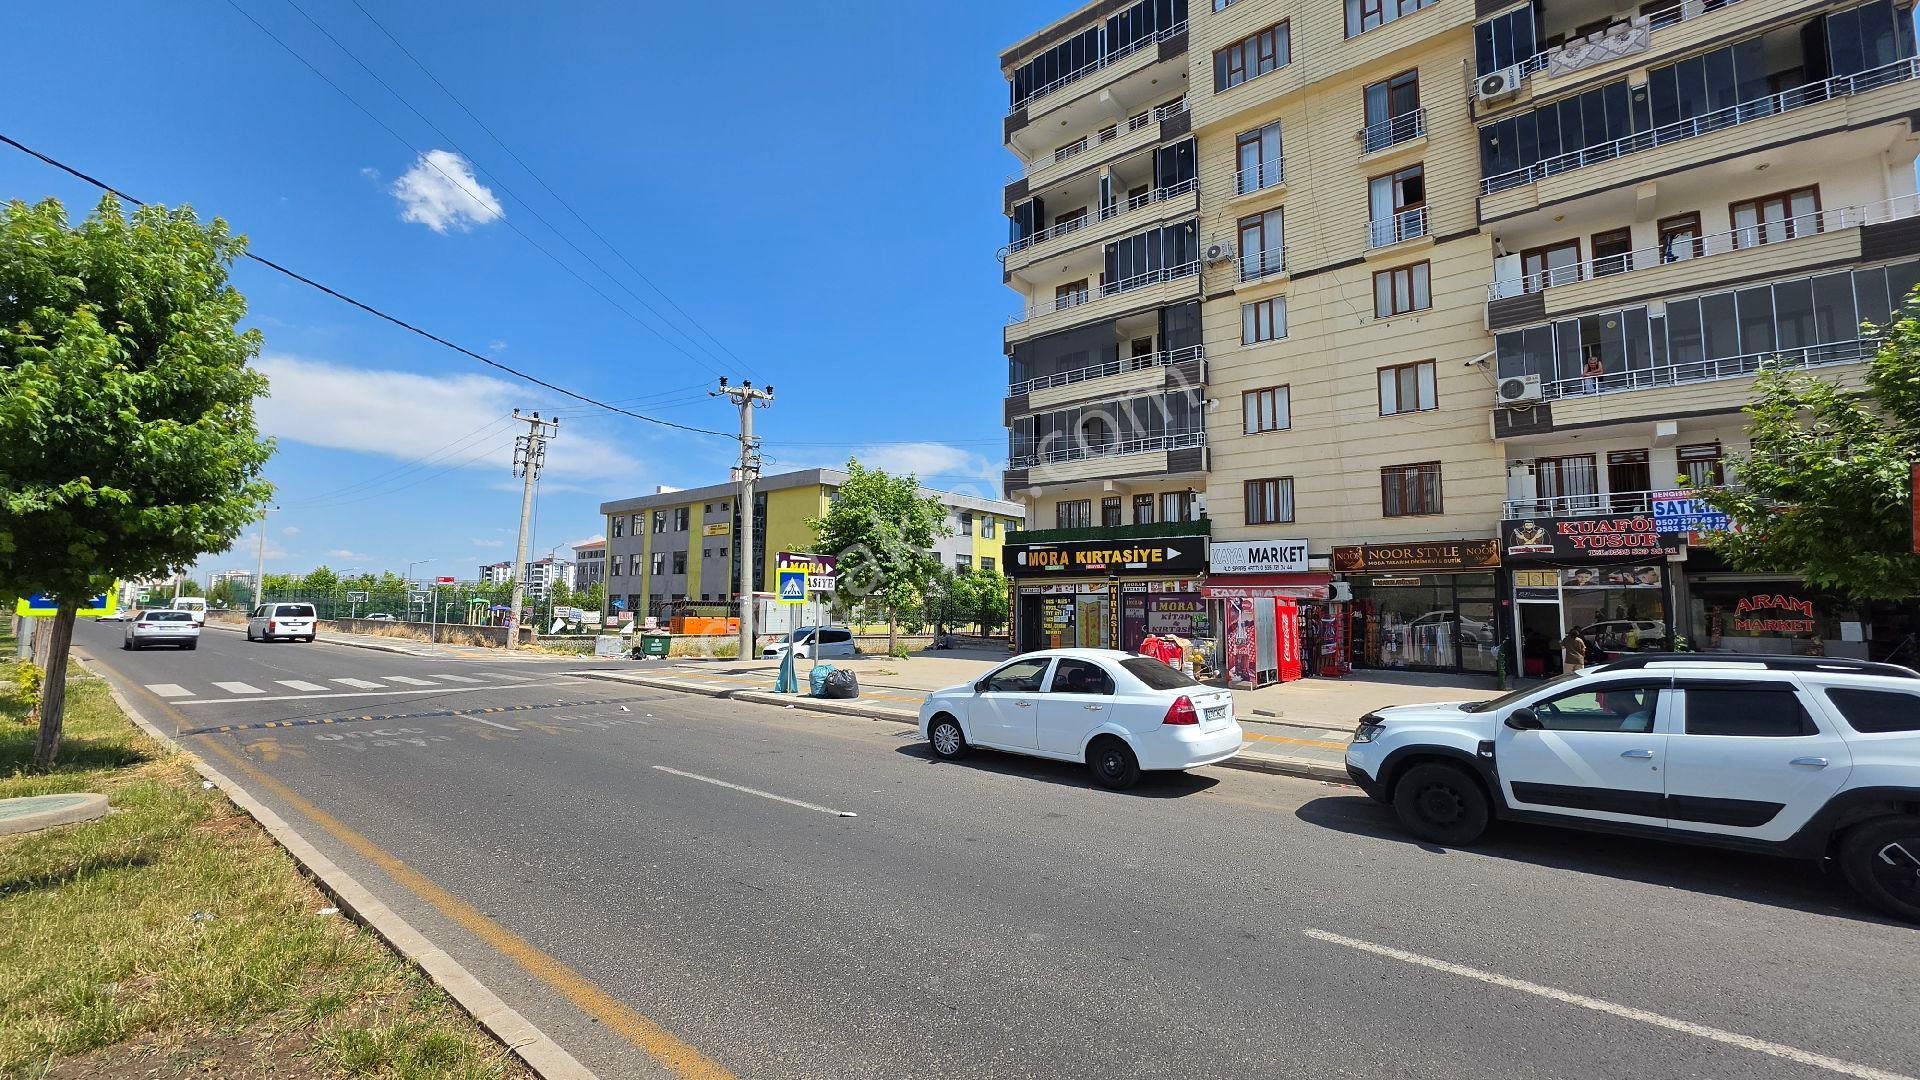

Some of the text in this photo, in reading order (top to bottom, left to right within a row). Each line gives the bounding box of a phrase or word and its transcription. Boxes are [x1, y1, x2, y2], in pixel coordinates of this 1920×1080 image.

[1569, 533, 1660, 548] YUSUF
[1028, 545, 1163, 567] MORA KIRTASİYE
[1211, 546, 1305, 565] KAYA MARKET
[1369, 546, 1459, 560] NOOR STYLE
[1210, 588, 1248, 597] KAYA
[1159, 601, 1194, 611] MORA
[1734, 594, 1814, 618] ARAM
[1734, 619, 1815, 632] MARKET
